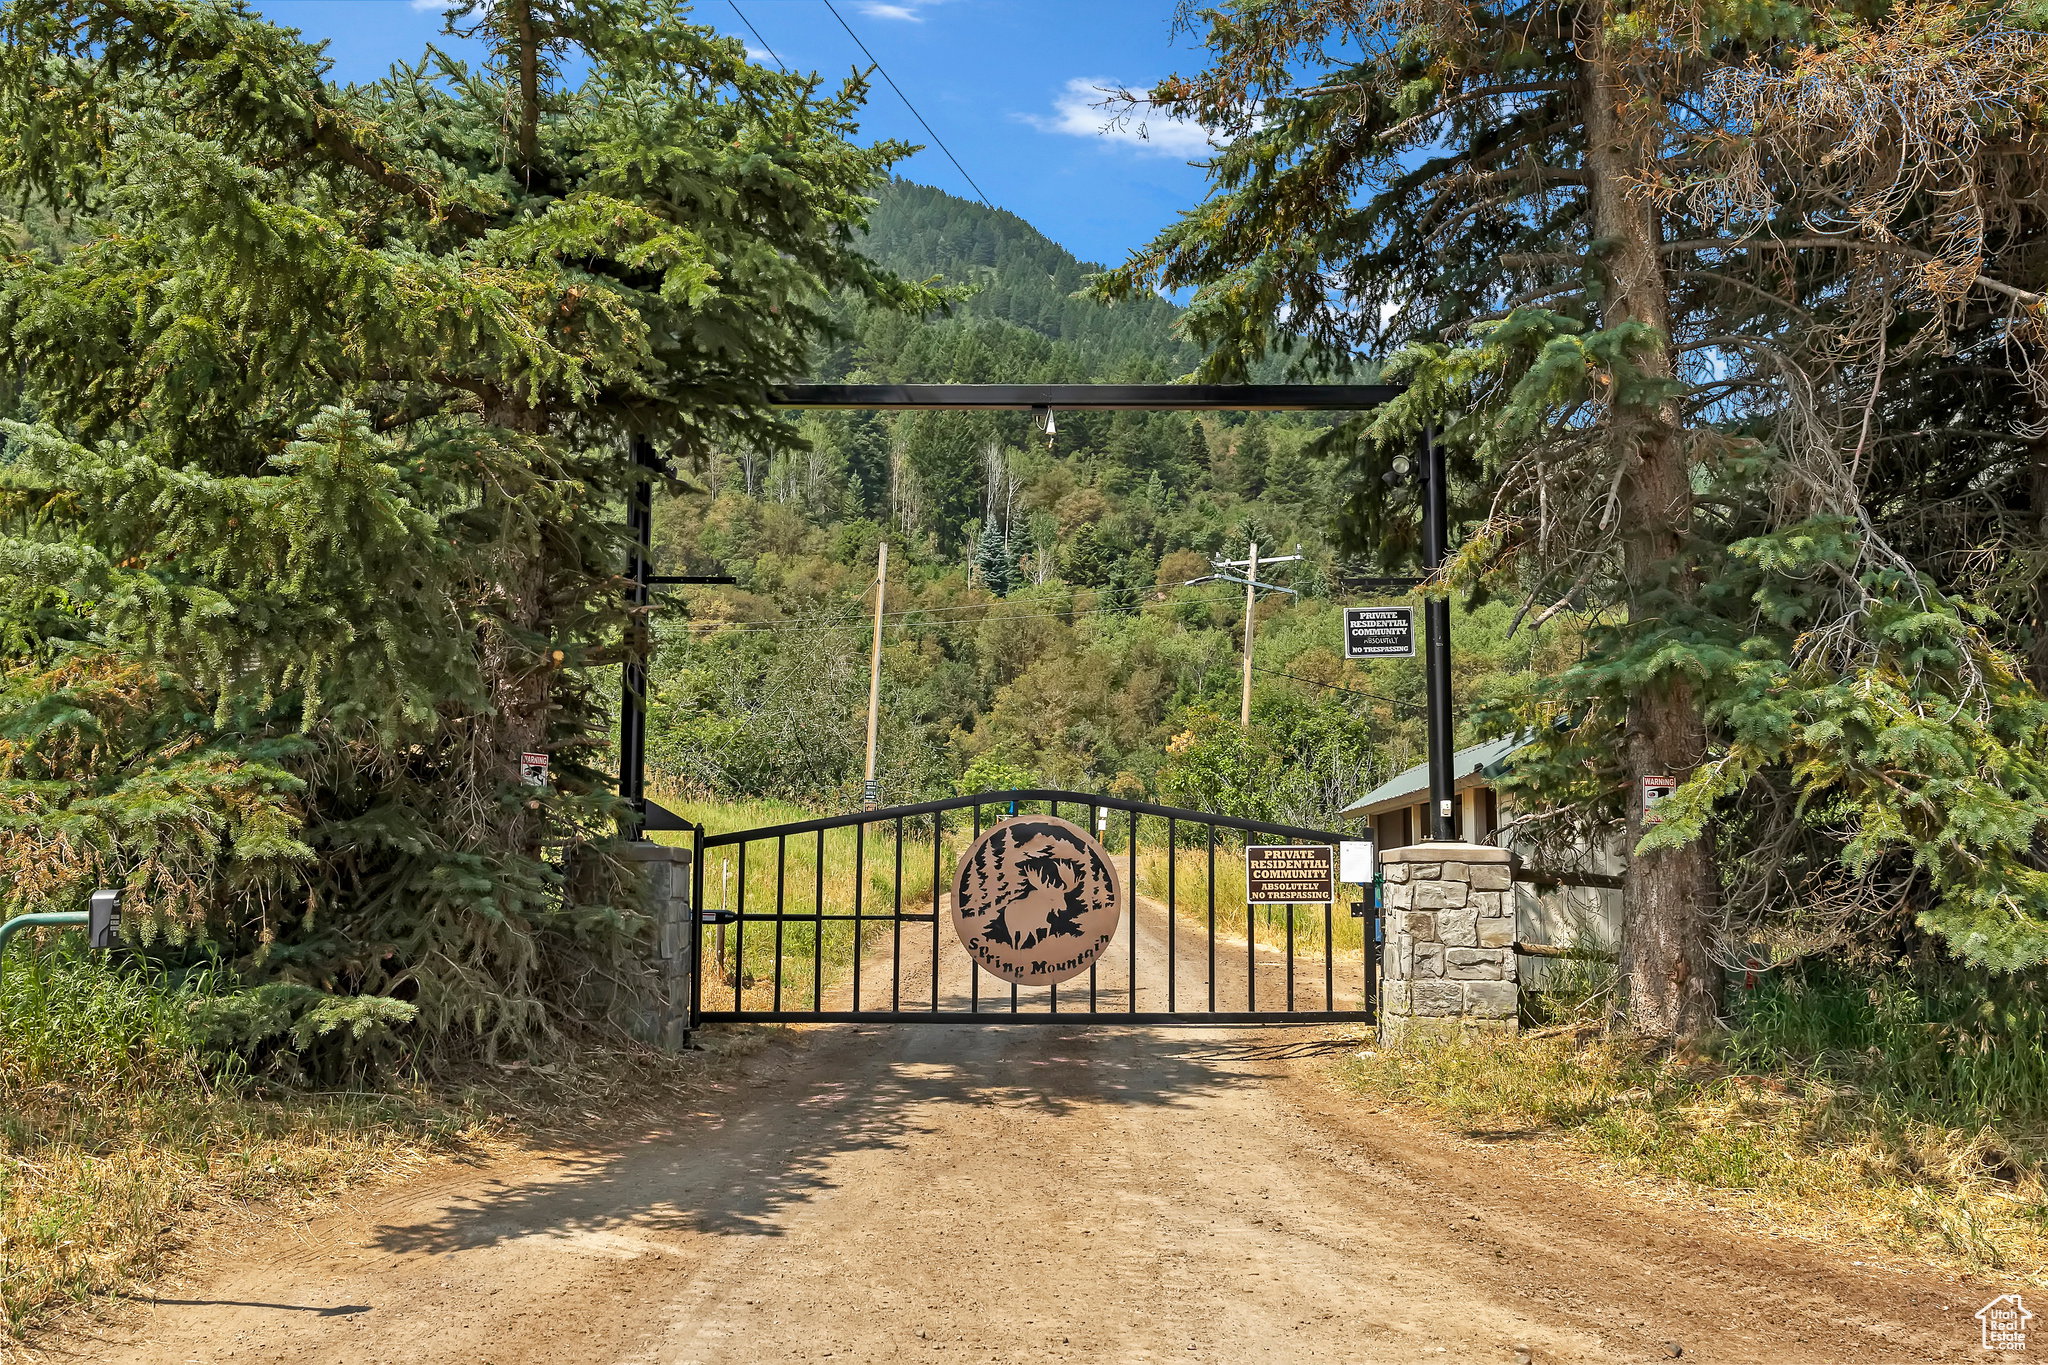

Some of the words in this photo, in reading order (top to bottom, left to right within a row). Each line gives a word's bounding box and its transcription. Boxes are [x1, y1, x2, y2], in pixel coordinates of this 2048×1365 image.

[1350, 620, 1408, 628] RESIDENTIAL
[1352, 628, 1408, 636] COMMUNITY
[1645, 778, 1674, 786] WARNING
[1264, 850, 1315, 859] PRIVATE
[1250, 860, 1329, 869] RESIDENTIAL
[1253, 870, 1327, 879] COMMUNITY
[1261, 883, 1320, 891] ABSOLUTELY
[1252, 892, 1266, 900] NO
[1267, 891, 1329, 899] TRESPASSING
[968, 937, 1024, 979] Spring
[1030, 934, 1109, 975] Mountain
